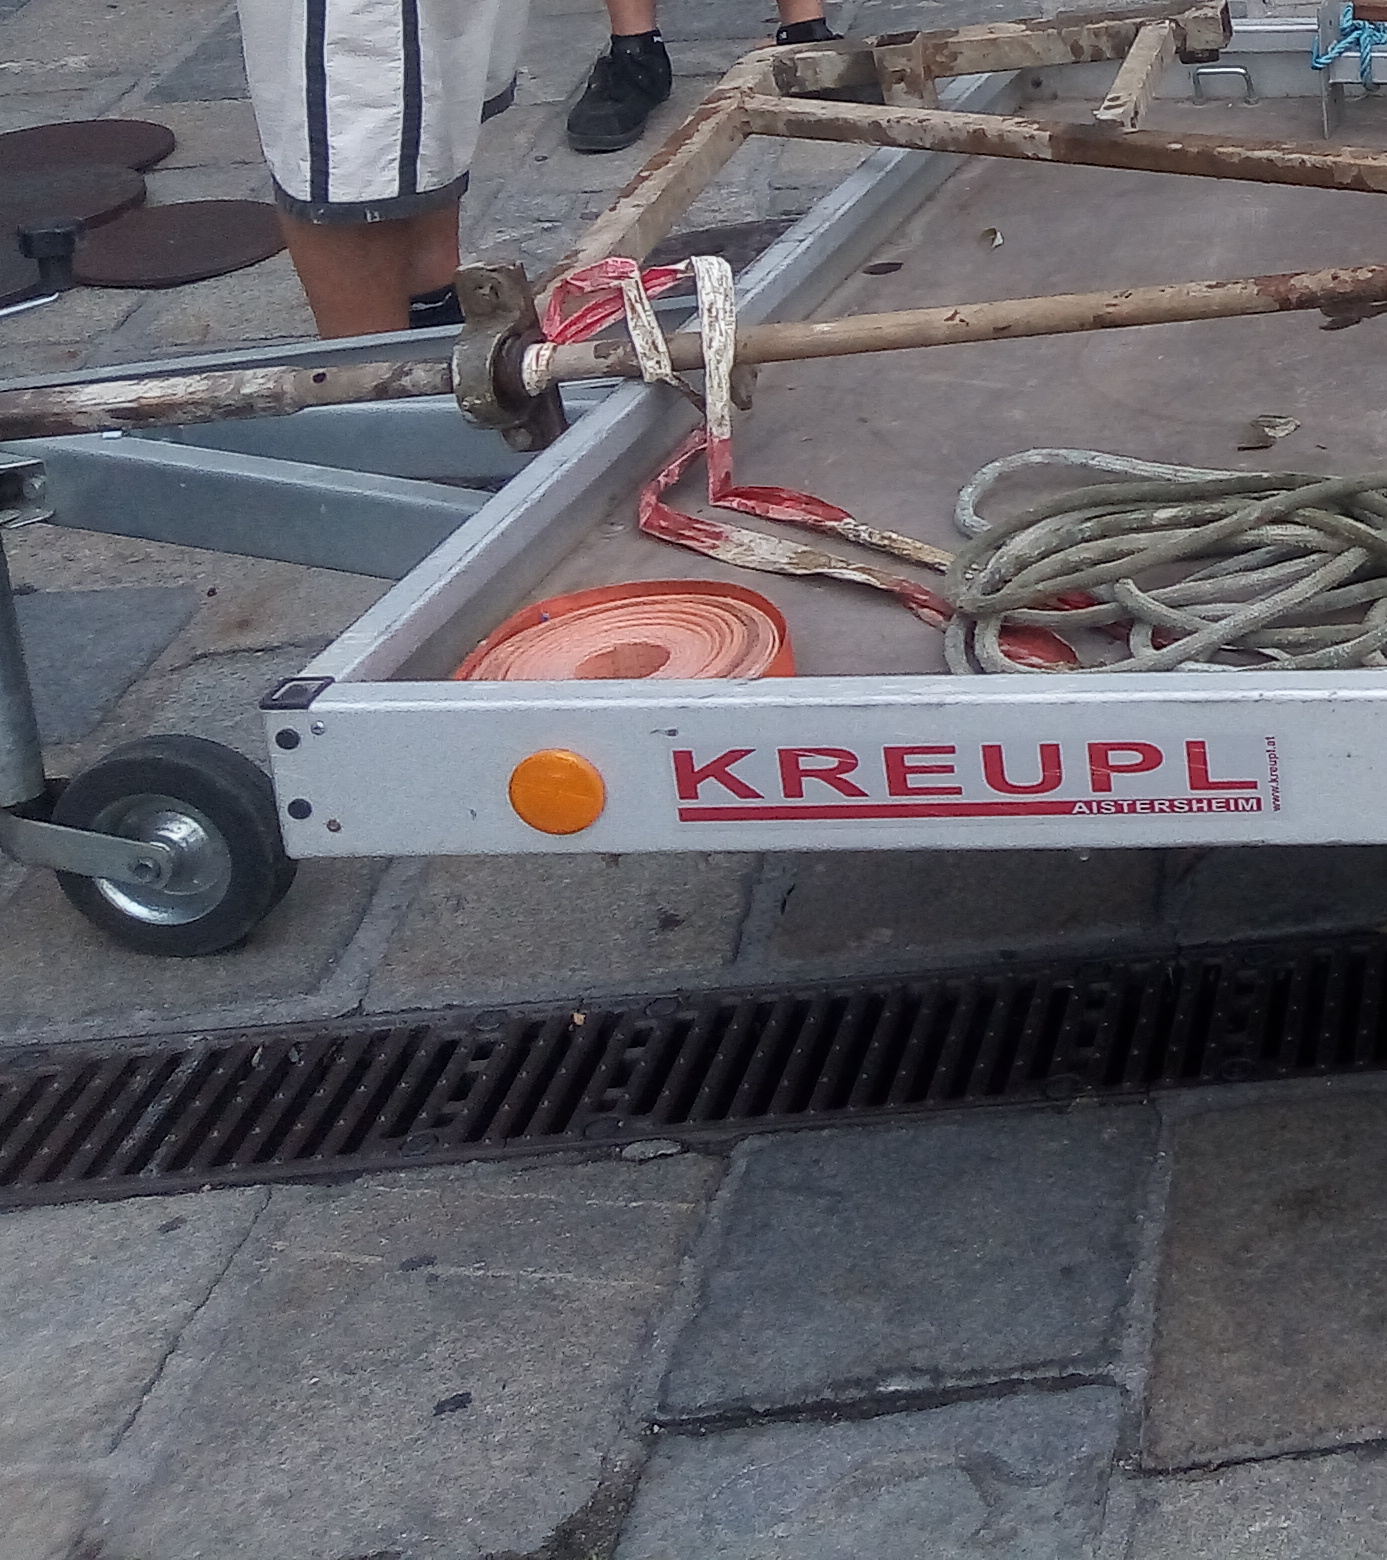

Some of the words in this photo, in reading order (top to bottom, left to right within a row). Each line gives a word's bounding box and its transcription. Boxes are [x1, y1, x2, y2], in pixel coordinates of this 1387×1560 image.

[670, 739, 1261, 802] KREUPL
[1264, 735, 1282, 812] www.kreupl.at
[1072, 797, 1261, 816] AISTERSHEIM
